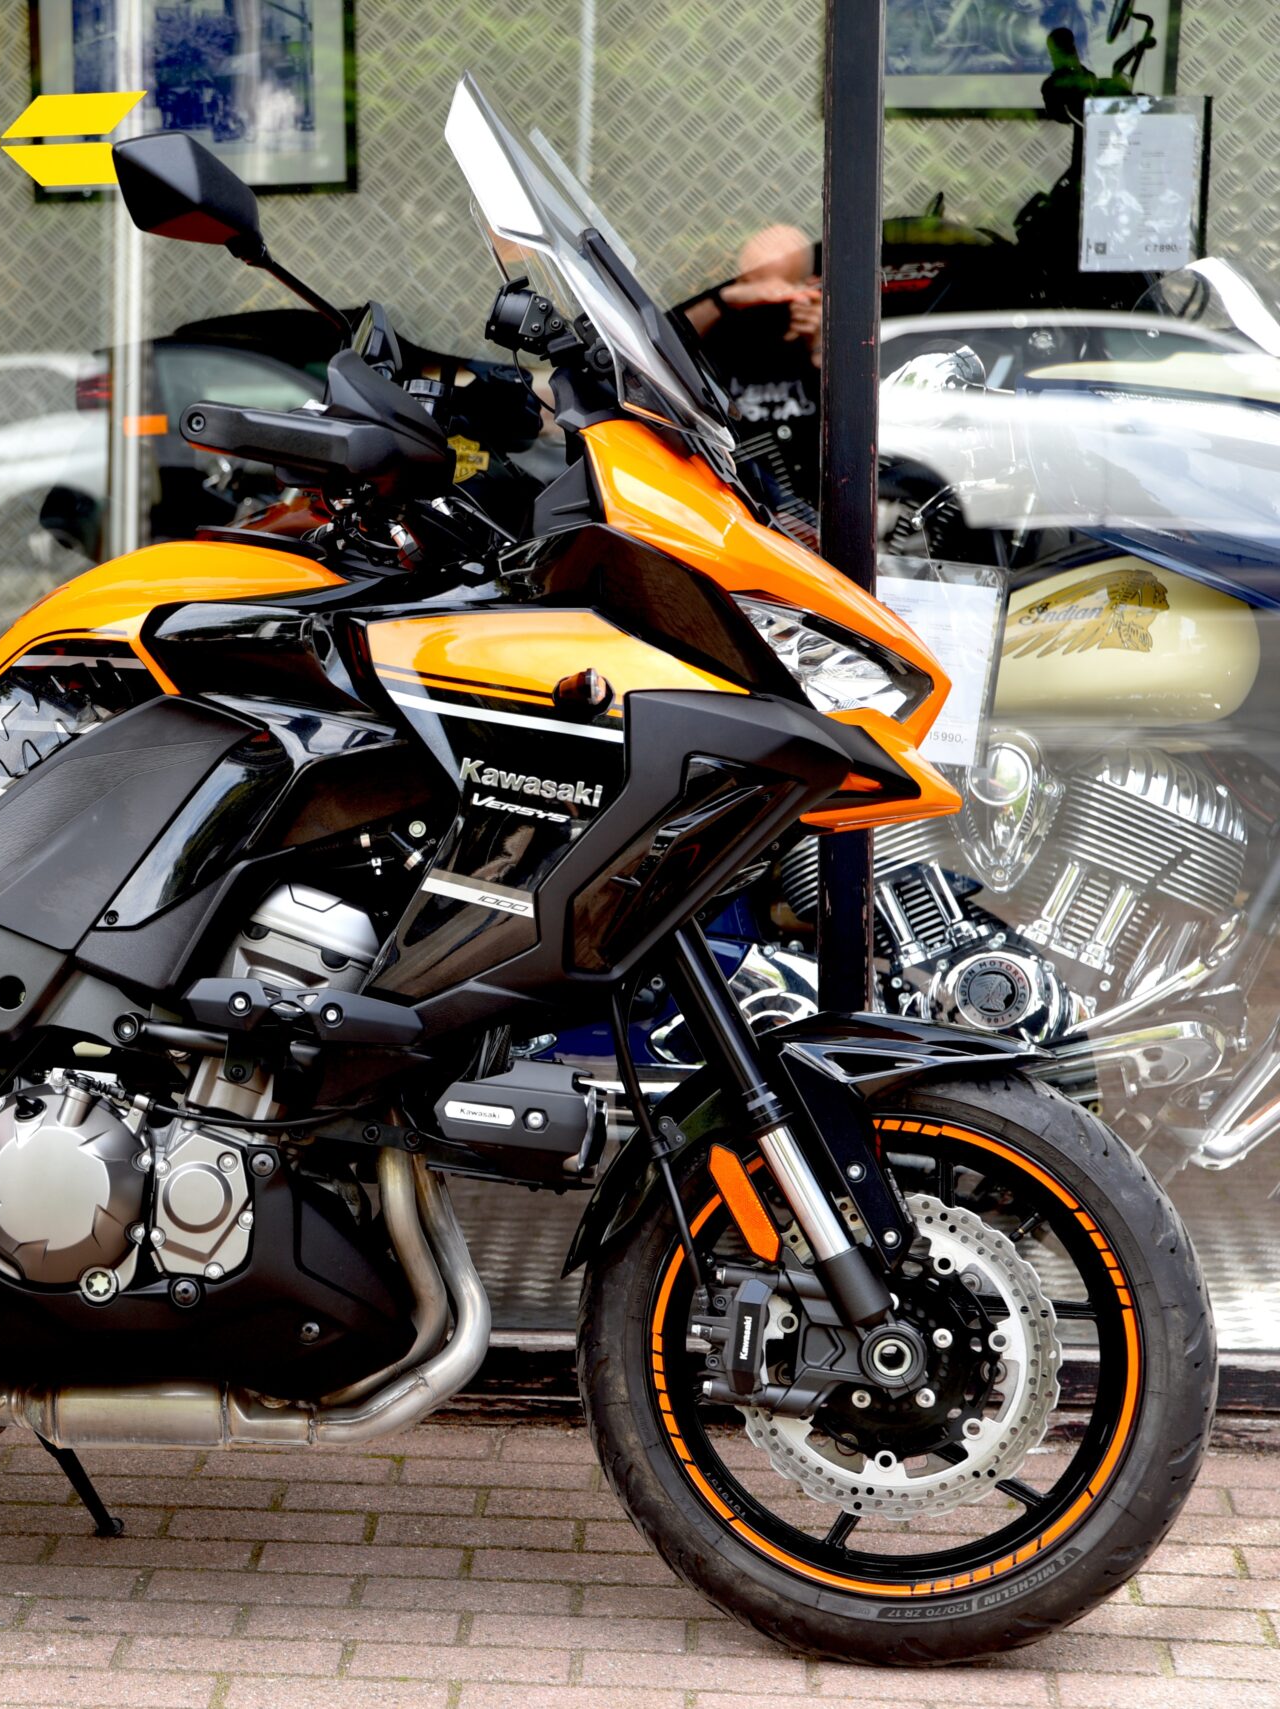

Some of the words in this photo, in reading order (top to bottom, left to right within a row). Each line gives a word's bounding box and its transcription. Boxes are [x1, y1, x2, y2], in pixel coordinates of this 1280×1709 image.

[1018, 601, 1104, 625] Indian
[459, 757, 604, 808] Kawasaki
[472, 792, 571, 823] VERSYS
[478, 895, 529, 912] 1000
[460, 1108, 500, 1119] Kawasaki
[739, 1316, 752, 1360] Kawasaki
[983, 1566, 1056, 1605] MICHELIN
[887, 1609, 901, 1617] 17
[904, 1609, 922, 1618] ZR
[926, 1603, 968, 1617] 120/70
